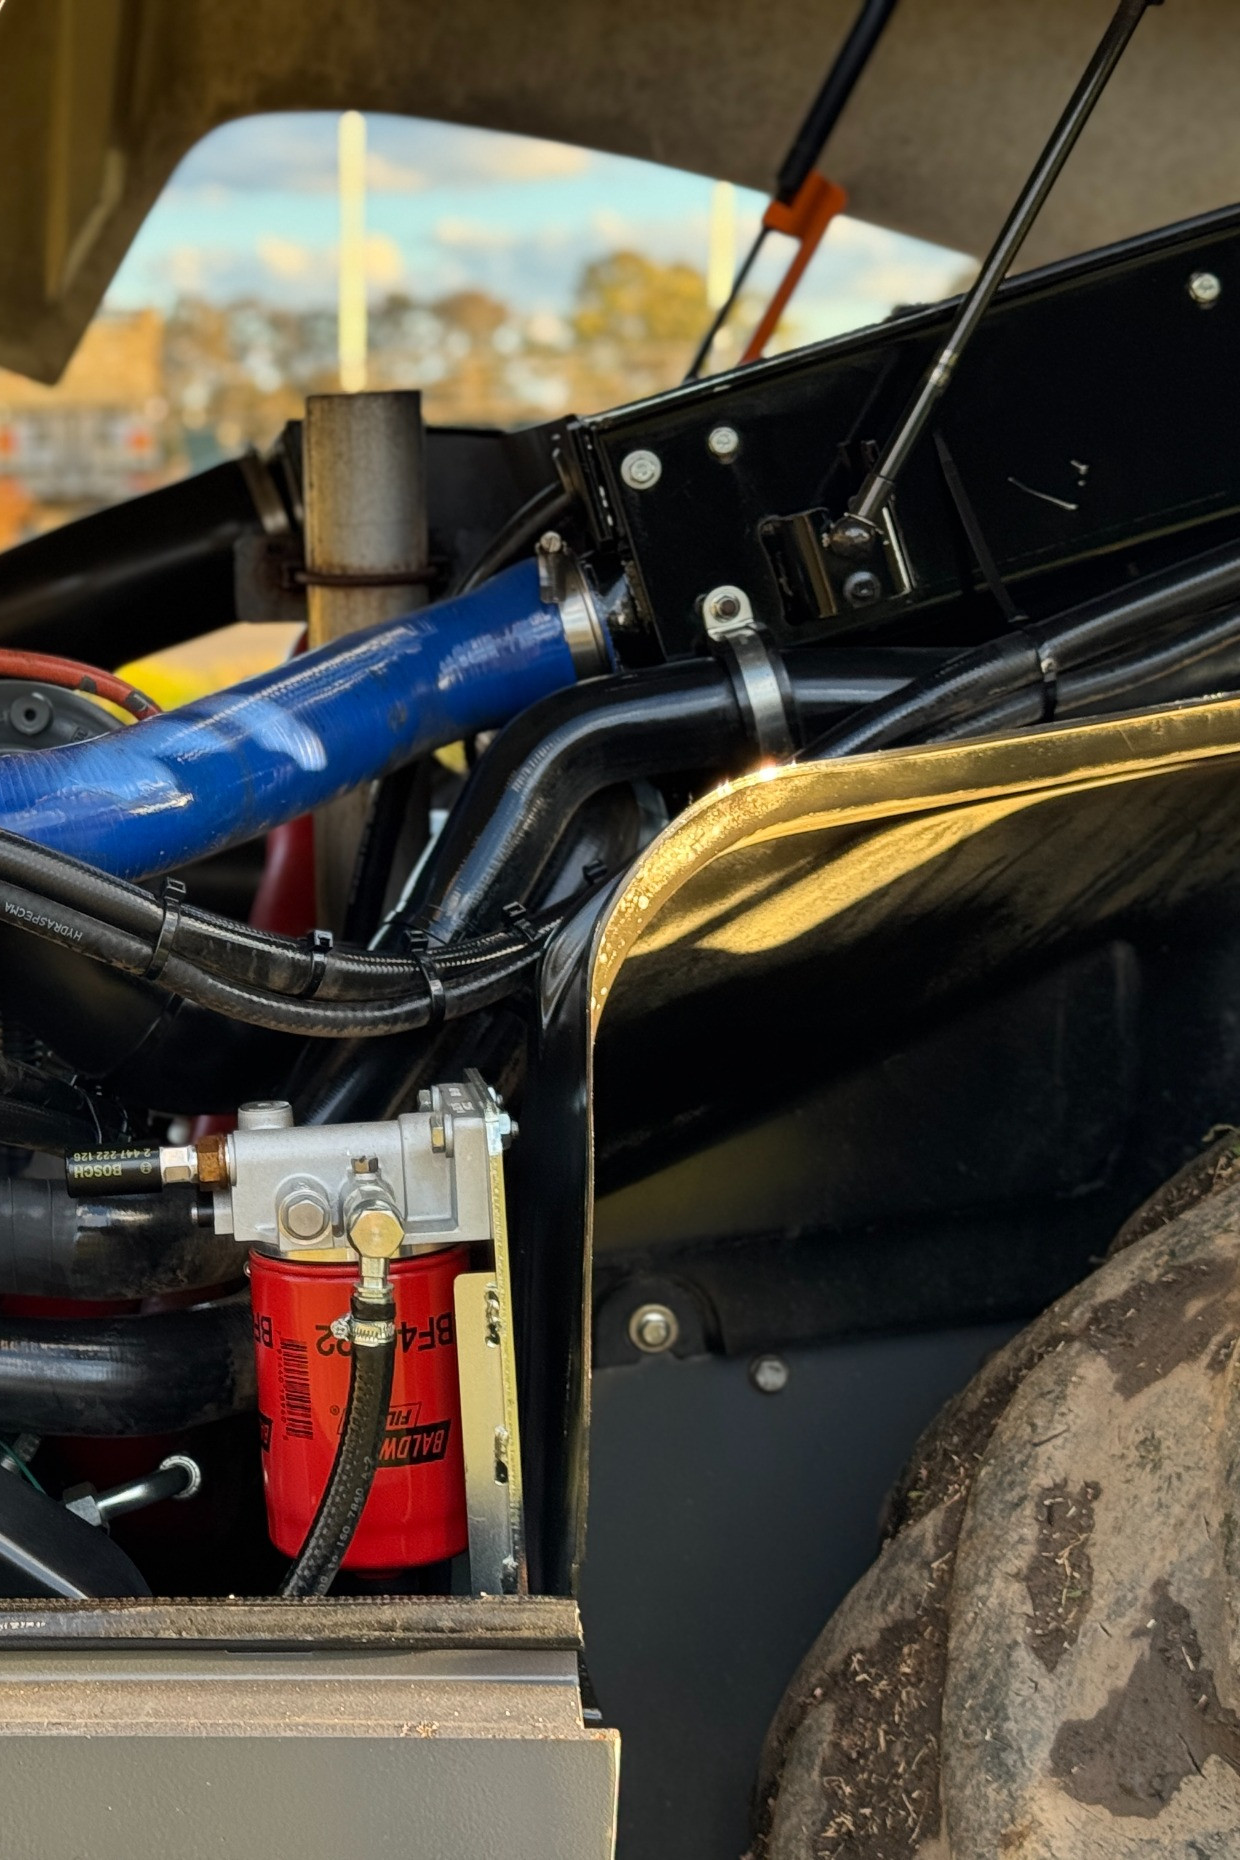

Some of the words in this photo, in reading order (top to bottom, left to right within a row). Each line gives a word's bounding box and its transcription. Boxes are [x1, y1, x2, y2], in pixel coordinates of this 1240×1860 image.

[4, 902, 83, 942] HYDRASPECMA
[73, 1151, 93, 1162] 126
[96, 1150, 117, 1161] 222
[120, 1149, 140, 1160] 447
[143, 1148, 151, 1158] 2
[74, 1163, 122, 1178] BOSCH
[379, 1429, 446, 1461] BALDW
